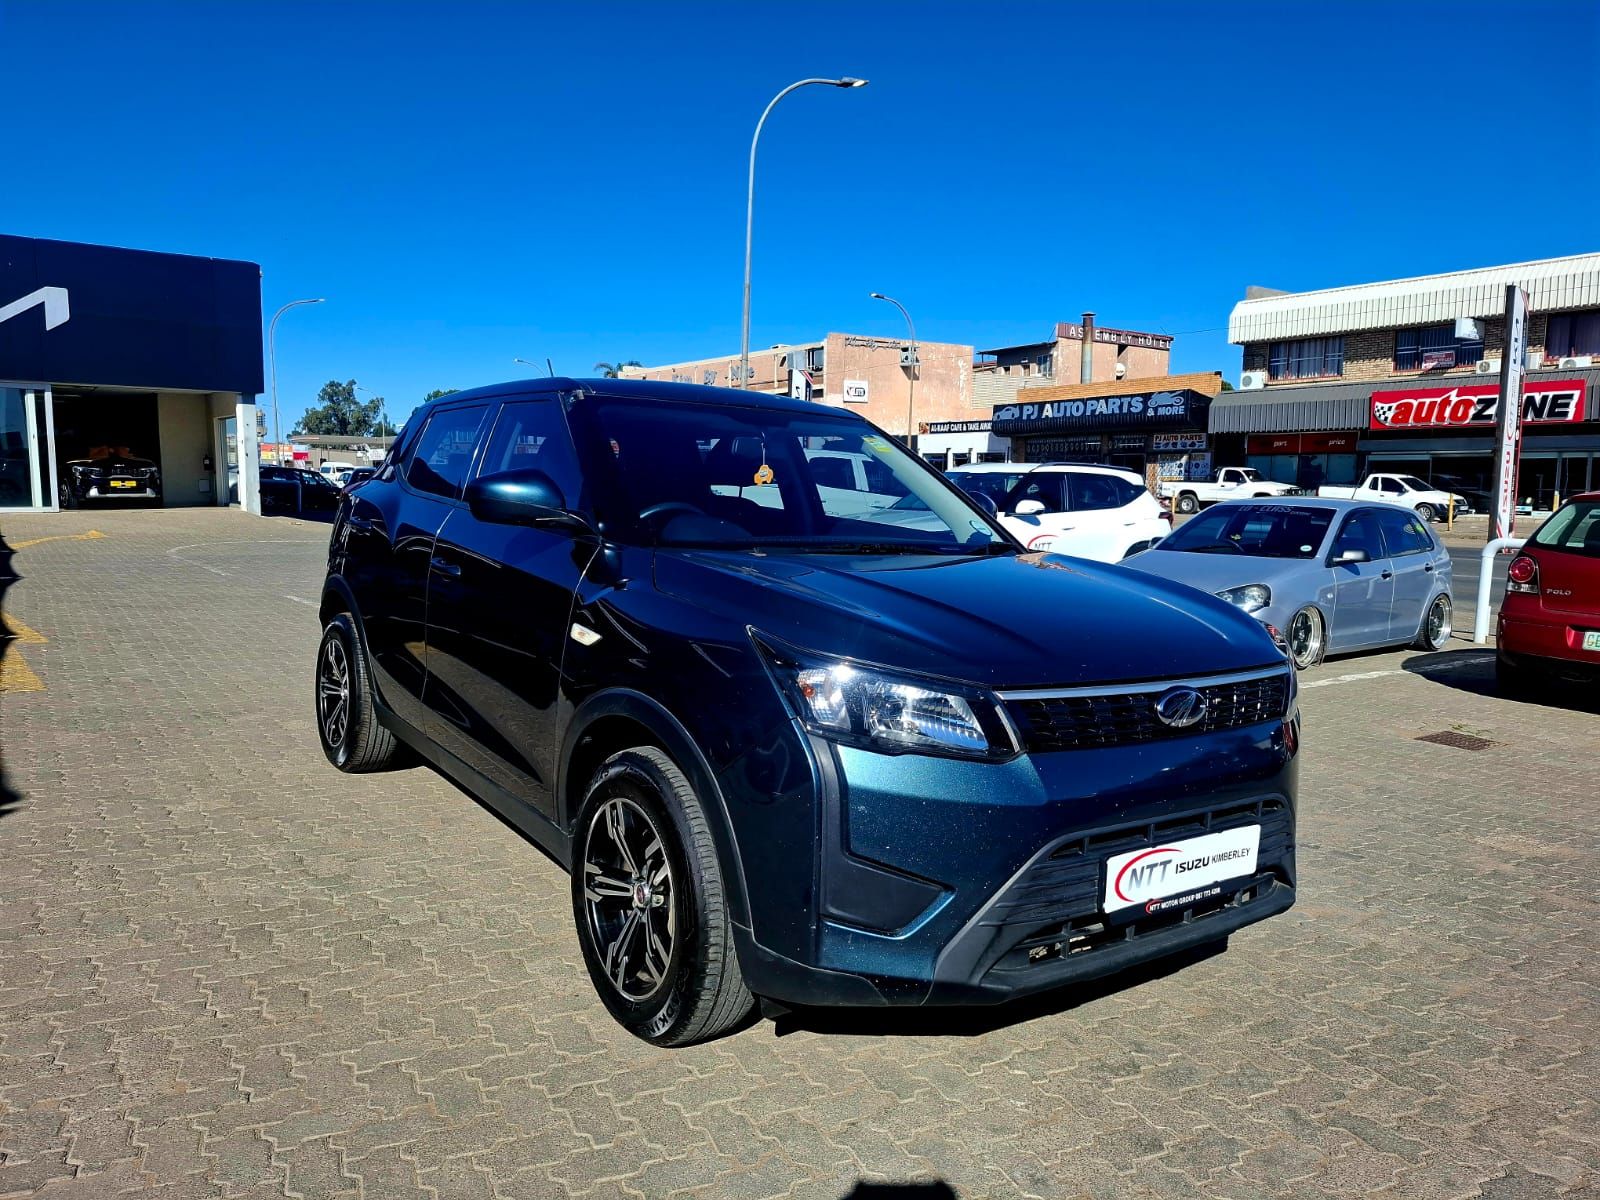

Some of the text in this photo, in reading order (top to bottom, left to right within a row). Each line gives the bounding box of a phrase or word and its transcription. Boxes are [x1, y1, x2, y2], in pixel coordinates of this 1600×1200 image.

[1069, 326, 1132, 343] ASEMBLY
[1022, 405, 1038, 420] PJ
[1146, 405, 1185, 416] & MORE
[1390, 392, 1575, 424] autoZNE
[967, 422, 979, 431] TAKE
[979, 422, 992, 430] AWA
[1546, 588, 1571, 596] POLO
[1127, 848, 1251, 892] NTT ISUZU KIMBERLEY
[1149, 902, 1161, 912] NTT
[1161, 899, 1179, 909] MOTOR
[1179, 894, 1195, 904] GROUP
